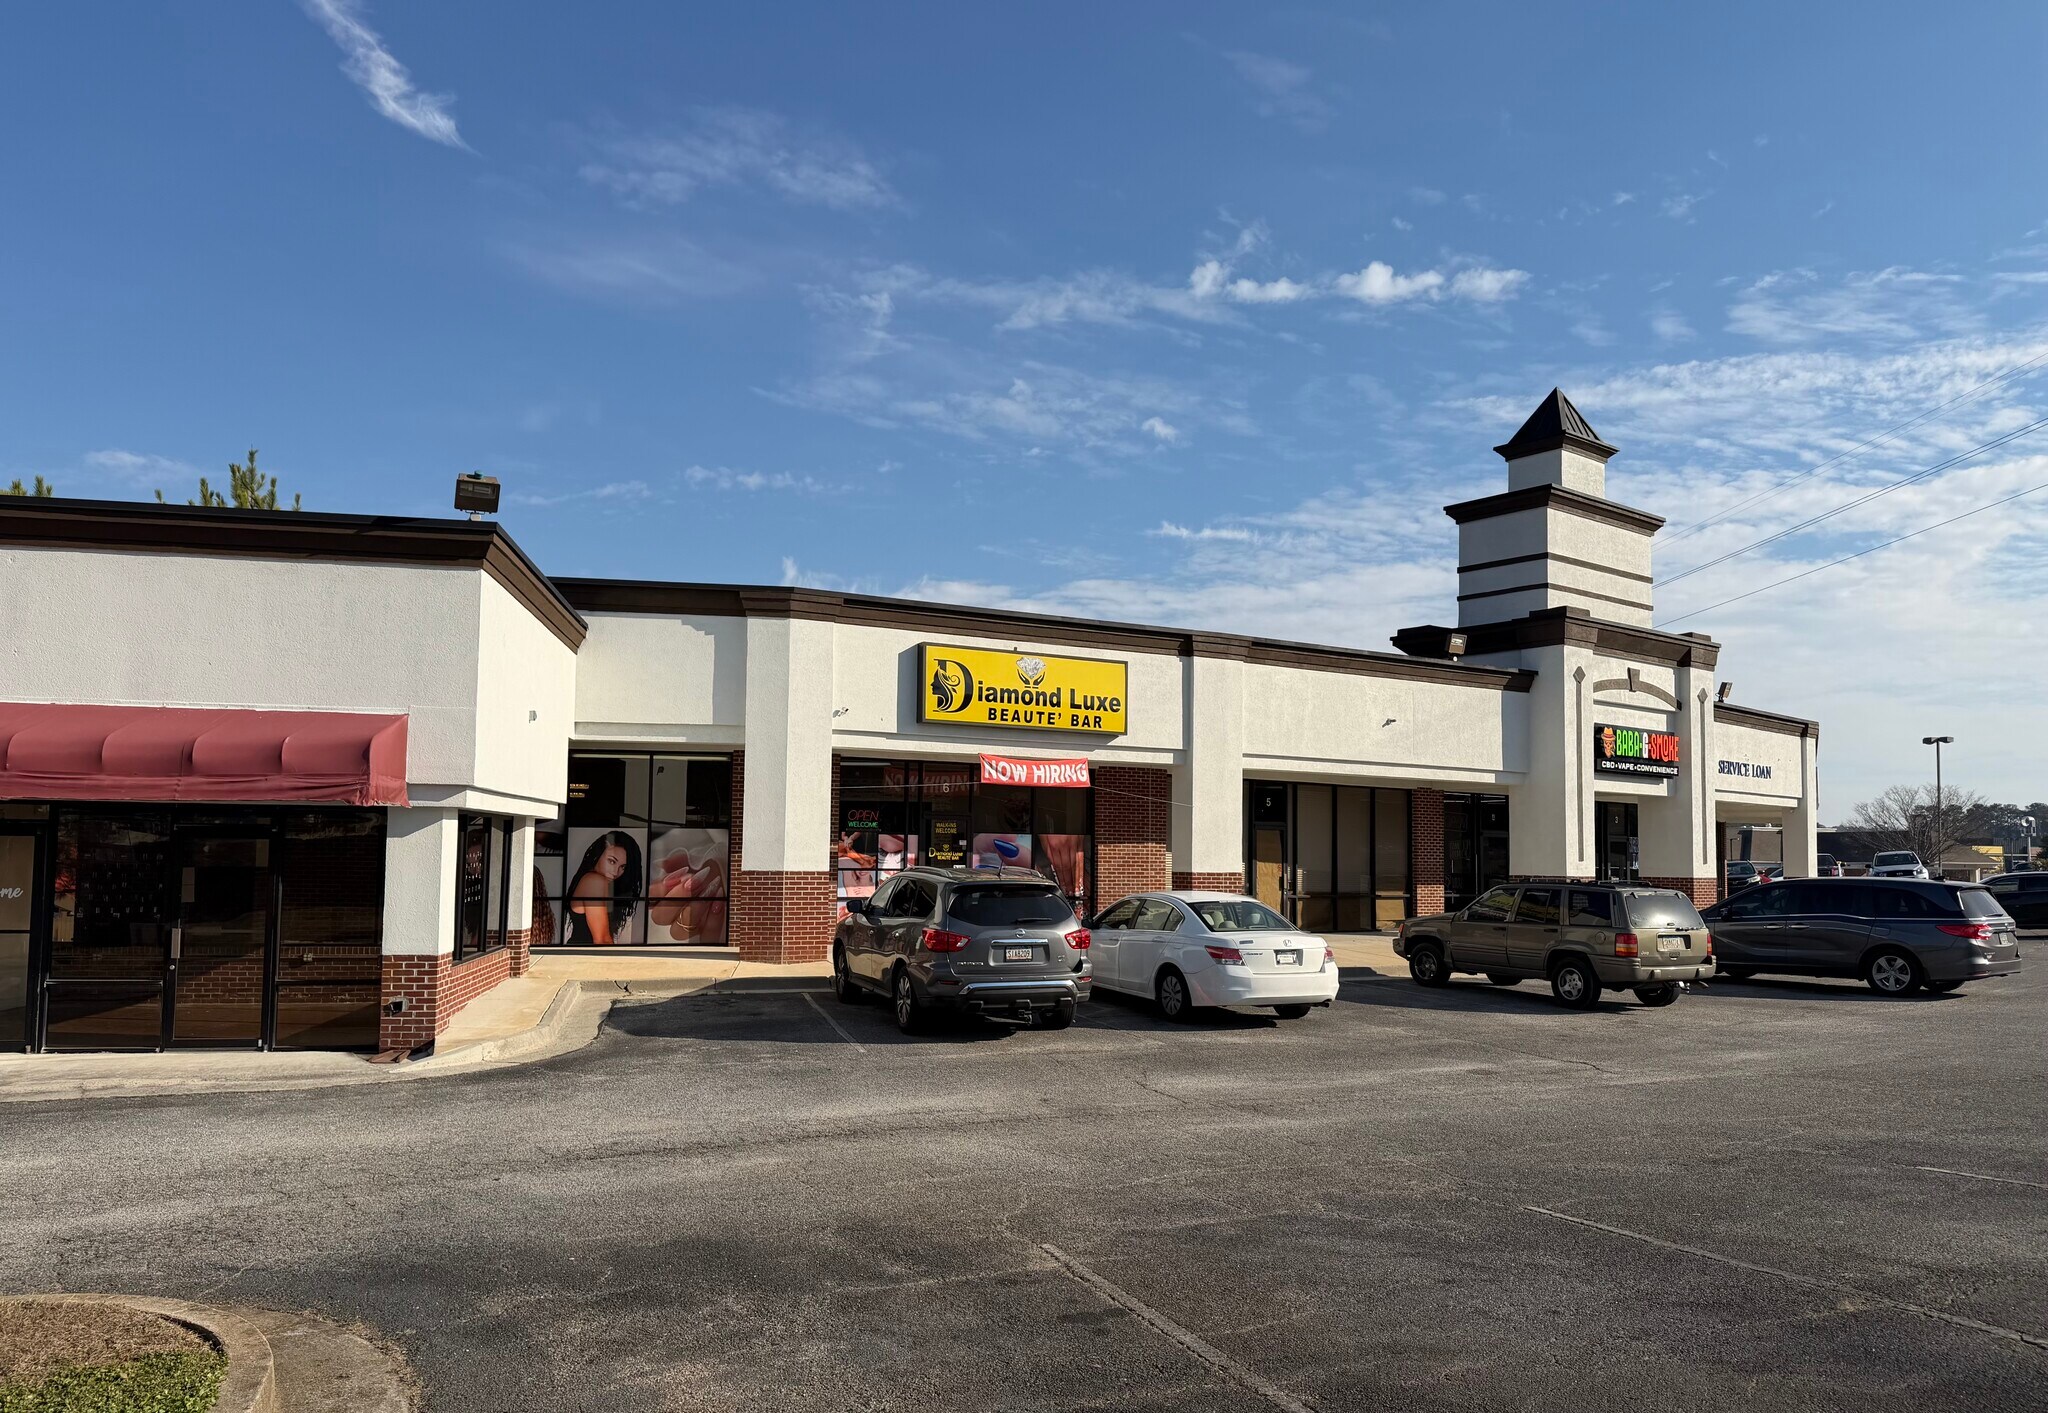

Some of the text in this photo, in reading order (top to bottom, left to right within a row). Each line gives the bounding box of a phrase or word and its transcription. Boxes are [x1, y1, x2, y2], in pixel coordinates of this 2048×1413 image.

[931, 658, 1121, 713] Diamond Luxe
[1070, 714, 1102, 728] BAR
[984, 760, 1087, 784] NOW HIRING
[1718, 760, 1771, 779] SERVICE LOAN
[942, 783, 950, 793] 6
[1266, 797, 1272, 807] 5
[848, 809, 880, 822] OPEN
